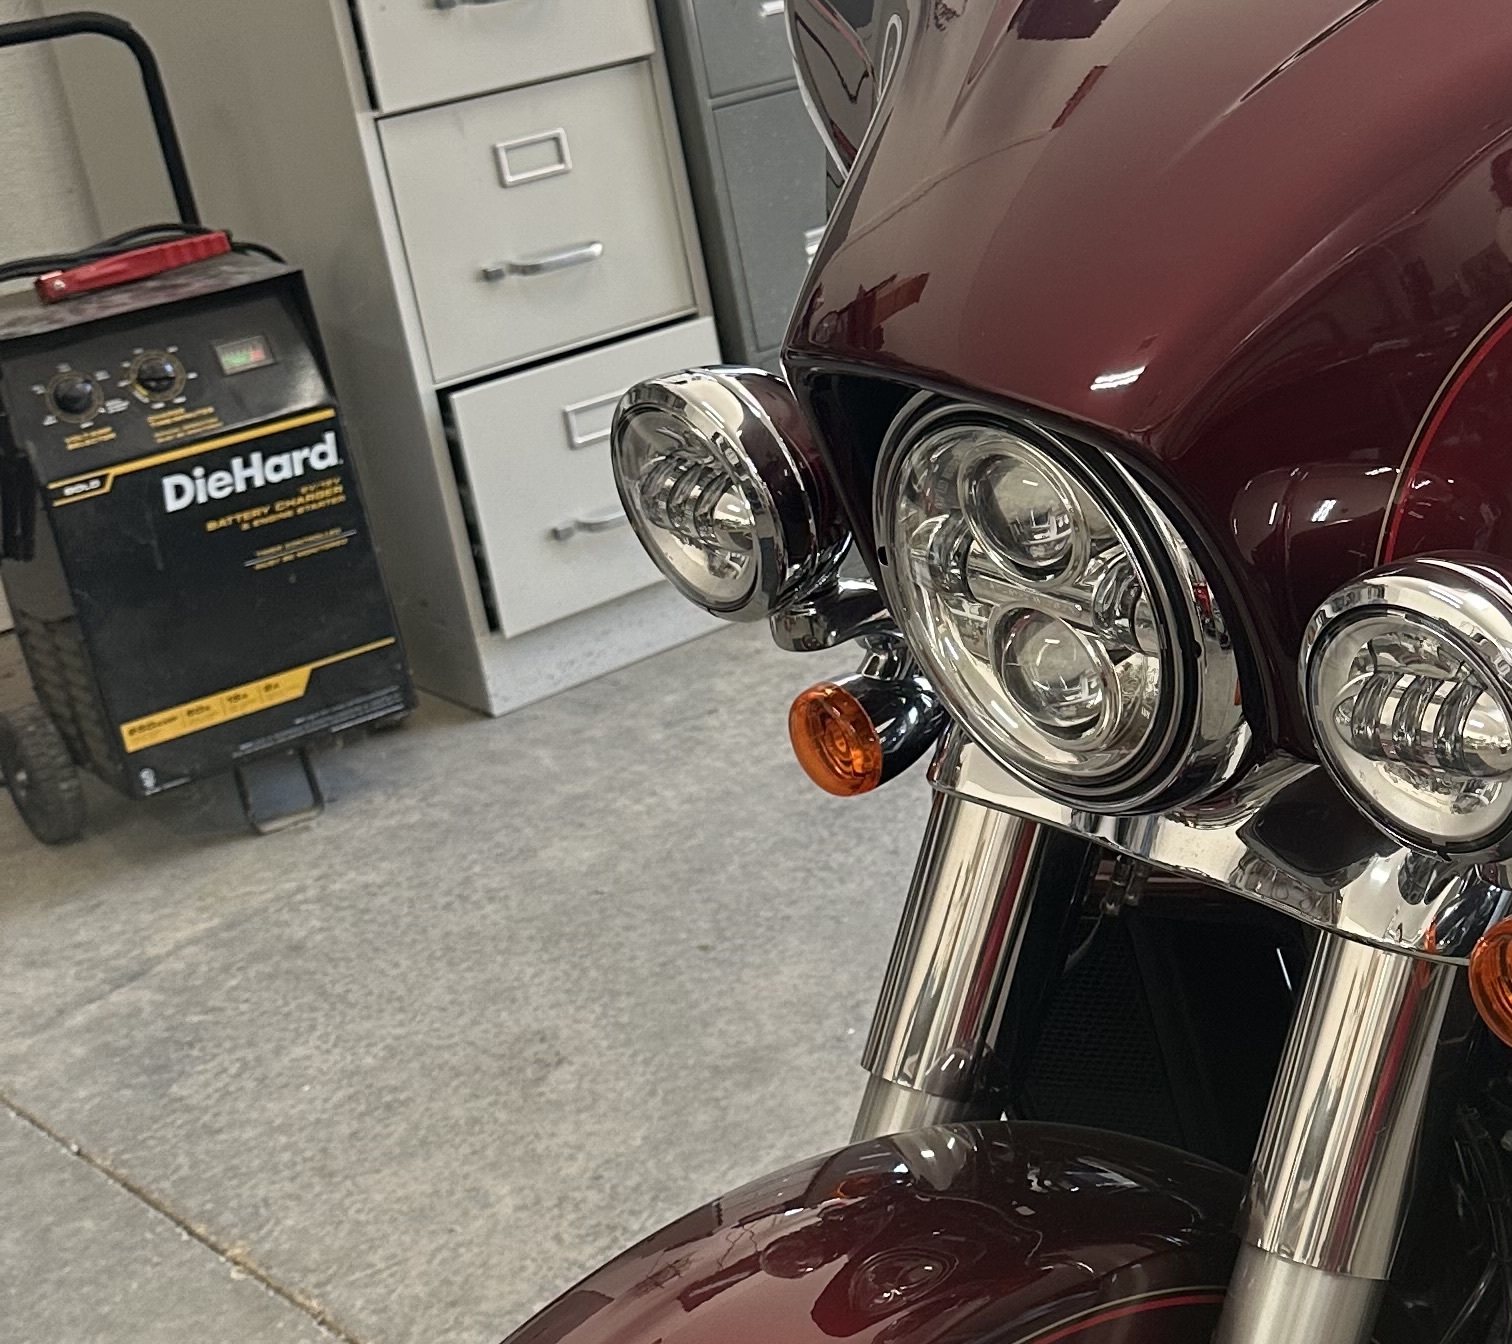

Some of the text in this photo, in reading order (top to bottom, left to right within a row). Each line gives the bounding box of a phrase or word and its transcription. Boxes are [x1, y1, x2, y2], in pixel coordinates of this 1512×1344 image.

[162, 430, 339, 513] DieHard
[205, 484, 344, 532] BATTERY CHARGER
